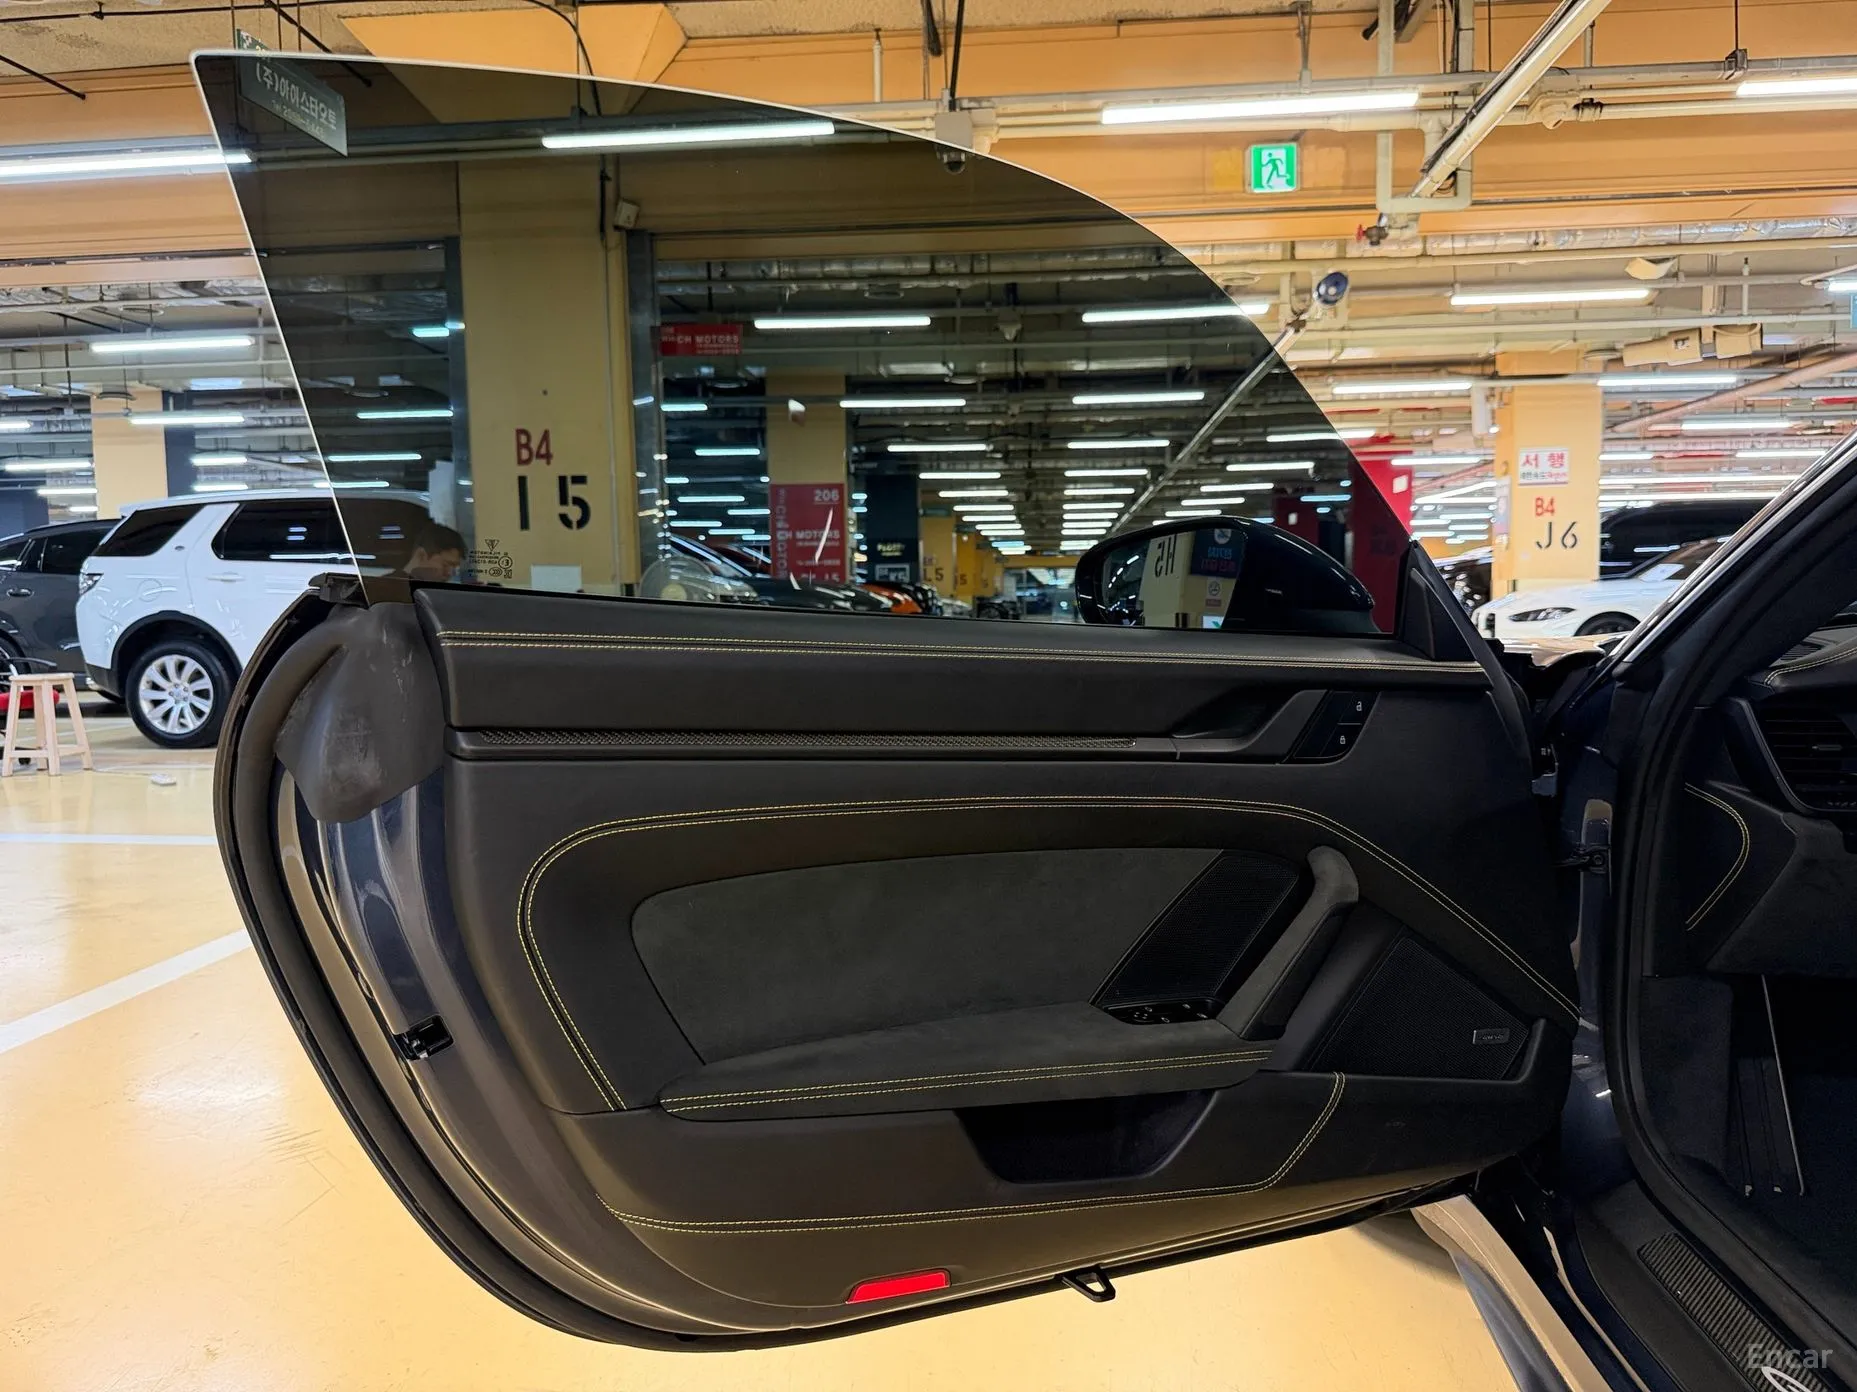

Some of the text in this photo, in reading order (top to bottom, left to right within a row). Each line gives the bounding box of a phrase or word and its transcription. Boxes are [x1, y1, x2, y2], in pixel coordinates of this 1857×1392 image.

[515, 428, 553, 466] B4
[814, 488, 840, 502] 206
[1535, 497, 1555, 516] B4
